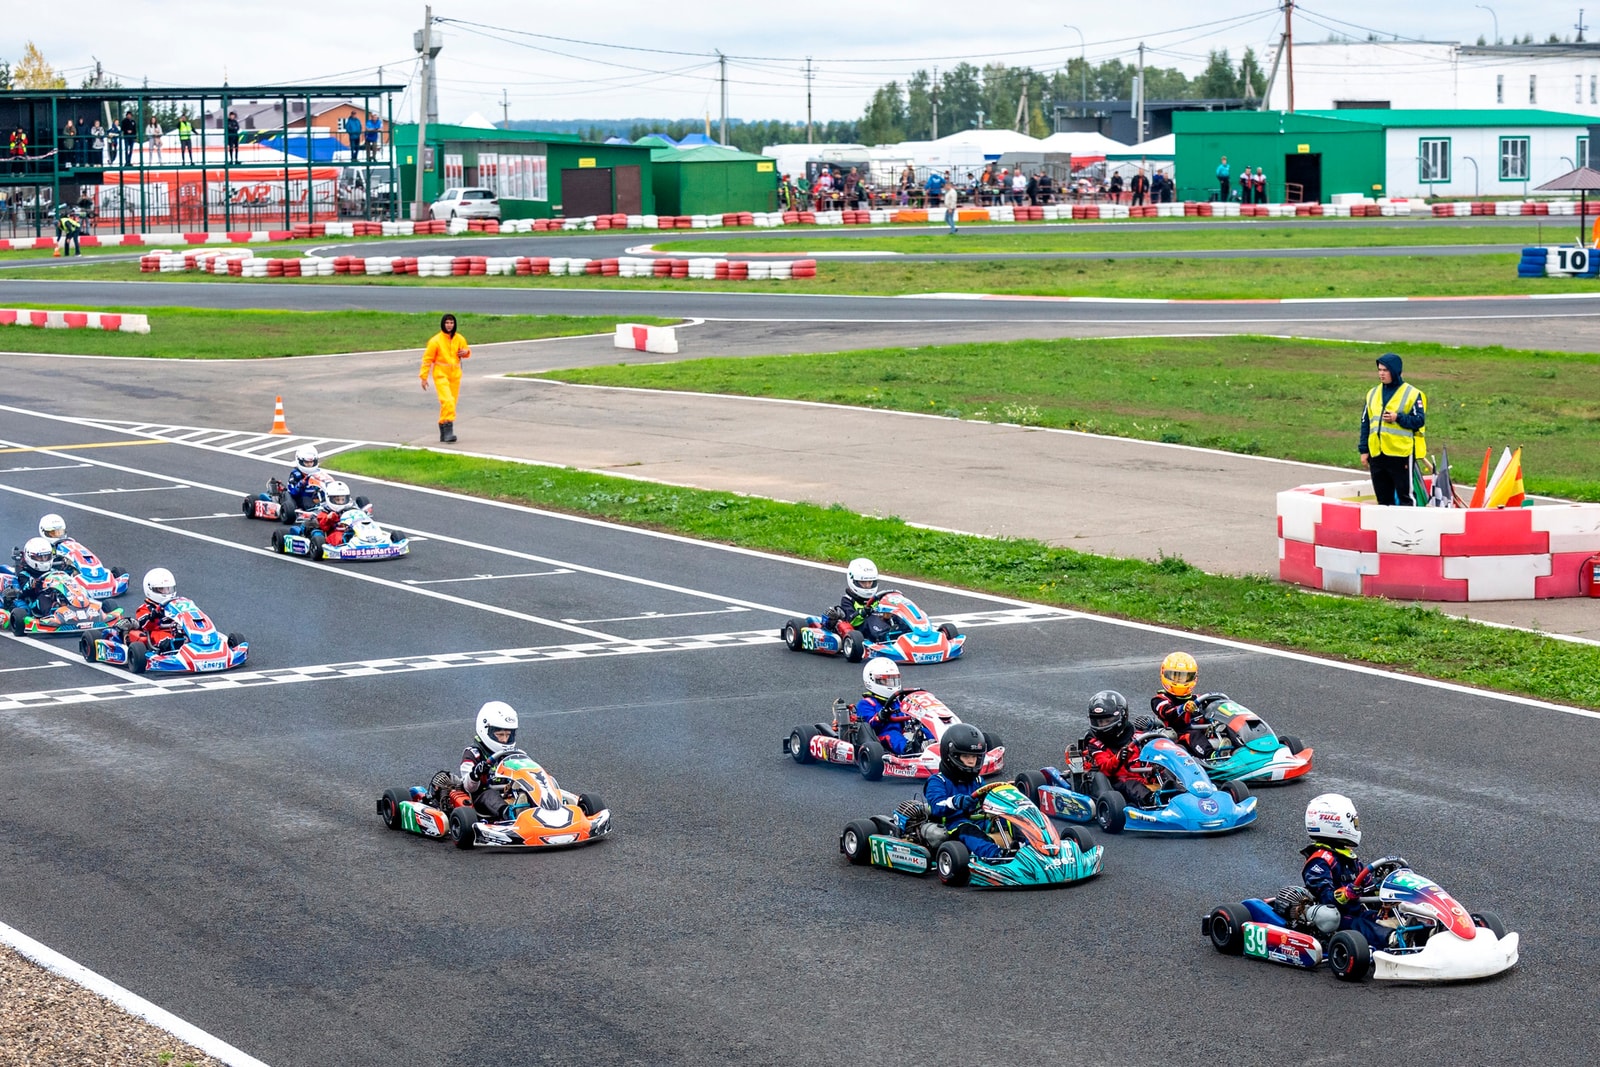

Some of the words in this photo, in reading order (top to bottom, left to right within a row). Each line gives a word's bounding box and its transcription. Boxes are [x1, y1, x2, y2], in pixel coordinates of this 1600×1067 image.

[1557, 250, 1587, 270] 10
[803, 631, 814, 649] 95
[810, 735, 824, 758] 55
[1319, 813, 1341, 821] TULA
[872, 840, 887, 865] 51
[1246, 924, 1267, 954] 39
